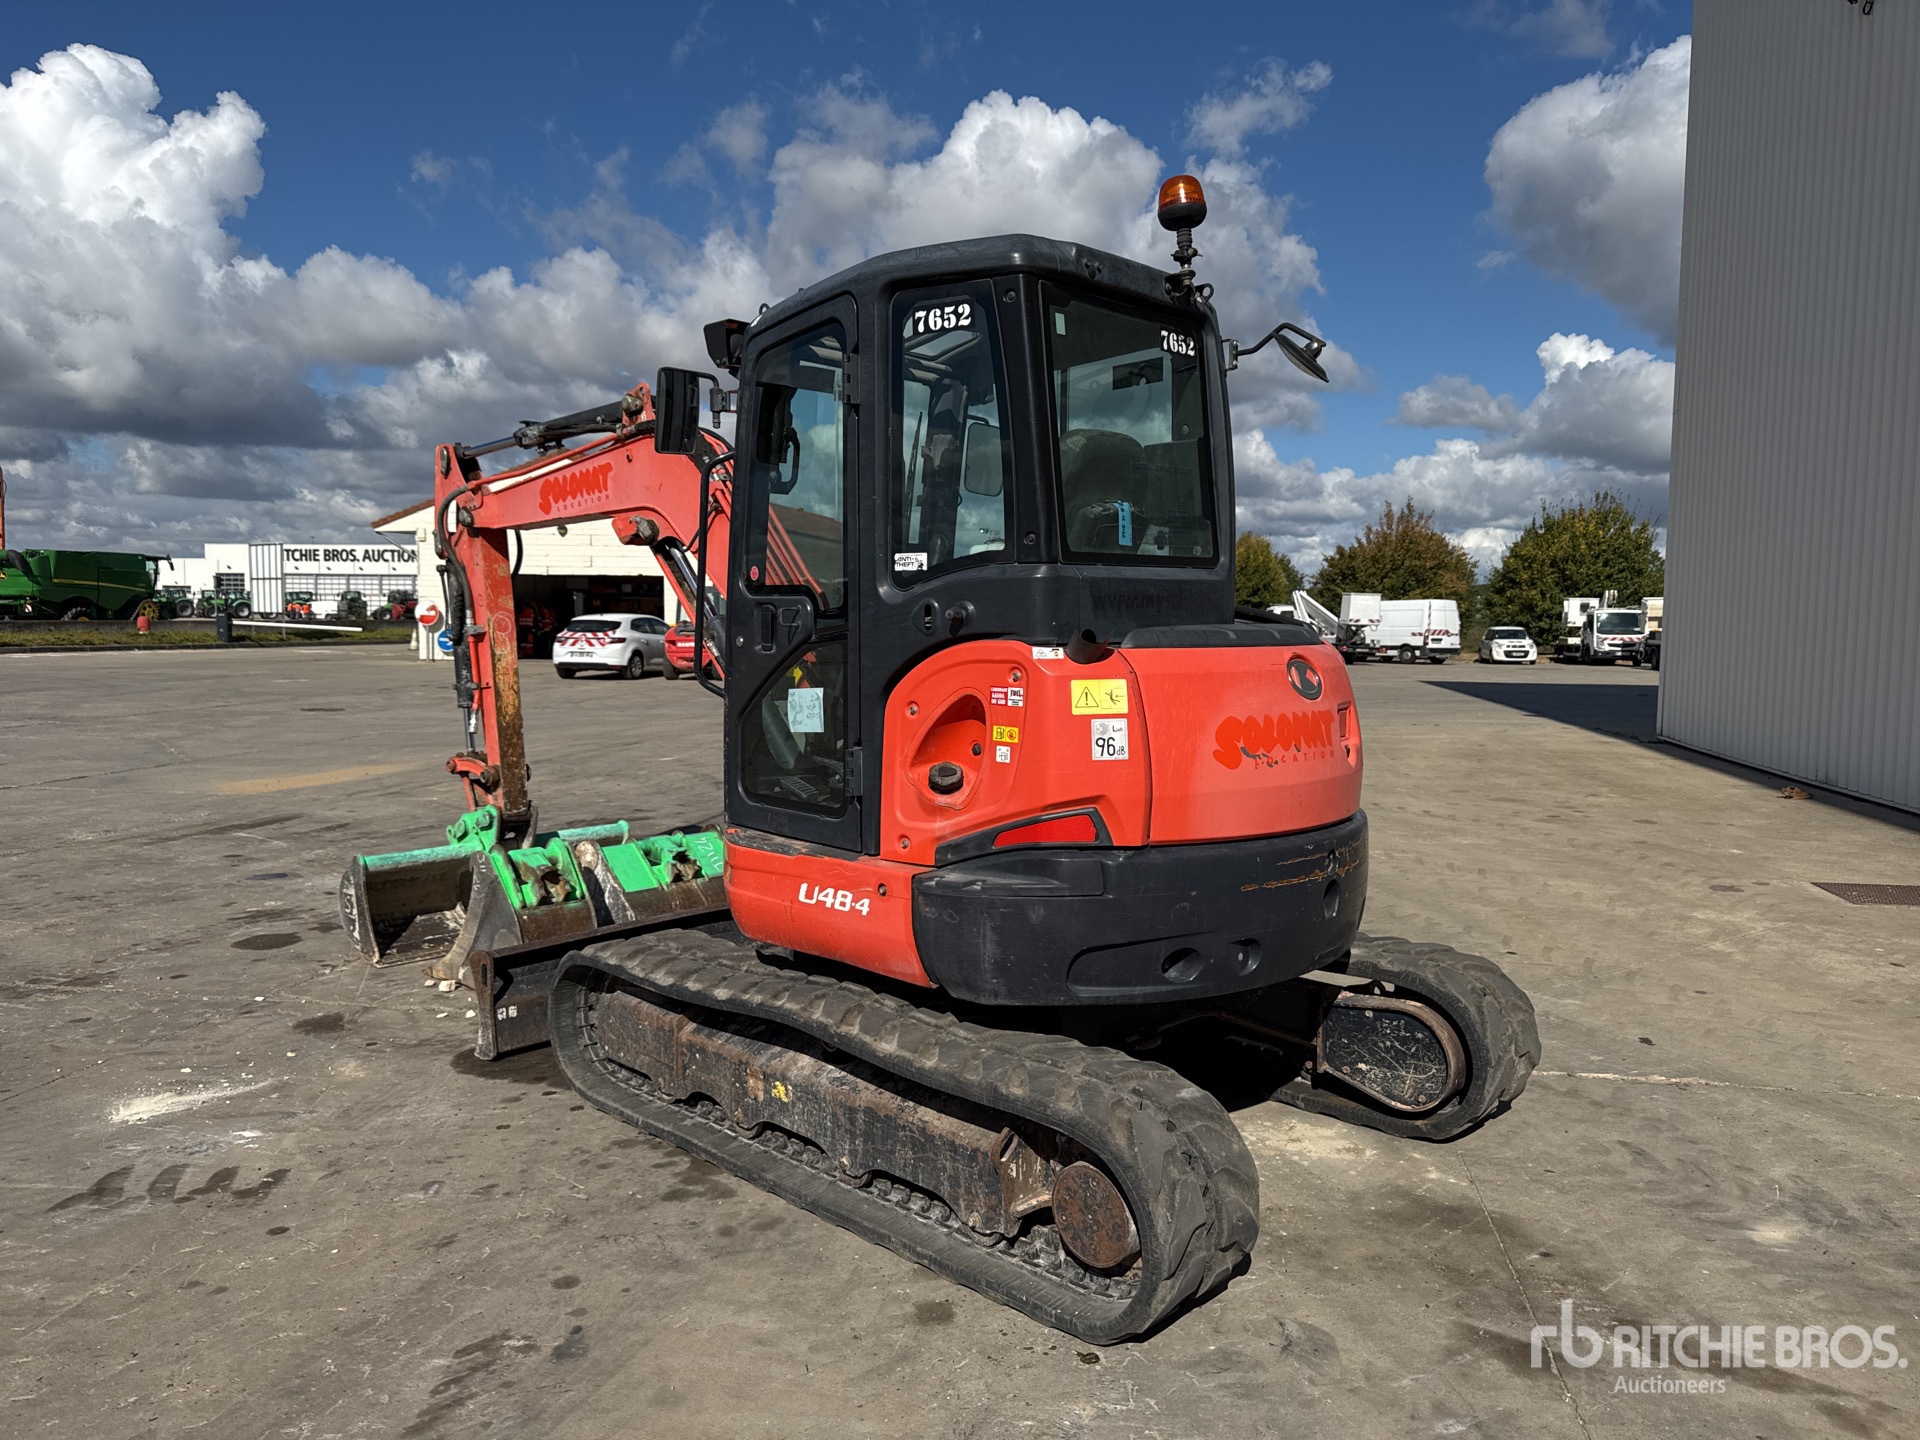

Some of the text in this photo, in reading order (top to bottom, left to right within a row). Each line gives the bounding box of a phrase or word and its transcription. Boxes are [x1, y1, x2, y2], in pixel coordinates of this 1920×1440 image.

[914, 303, 972, 333] 7652
[1160, 329, 1195, 357] 7652
[556, 493, 610, 512] LOCATION
[323, 549, 360, 563] BROS.
[1095, 736, 1126, 757] 96 dB
[1254, 750, 1335, 767] LOCATION
